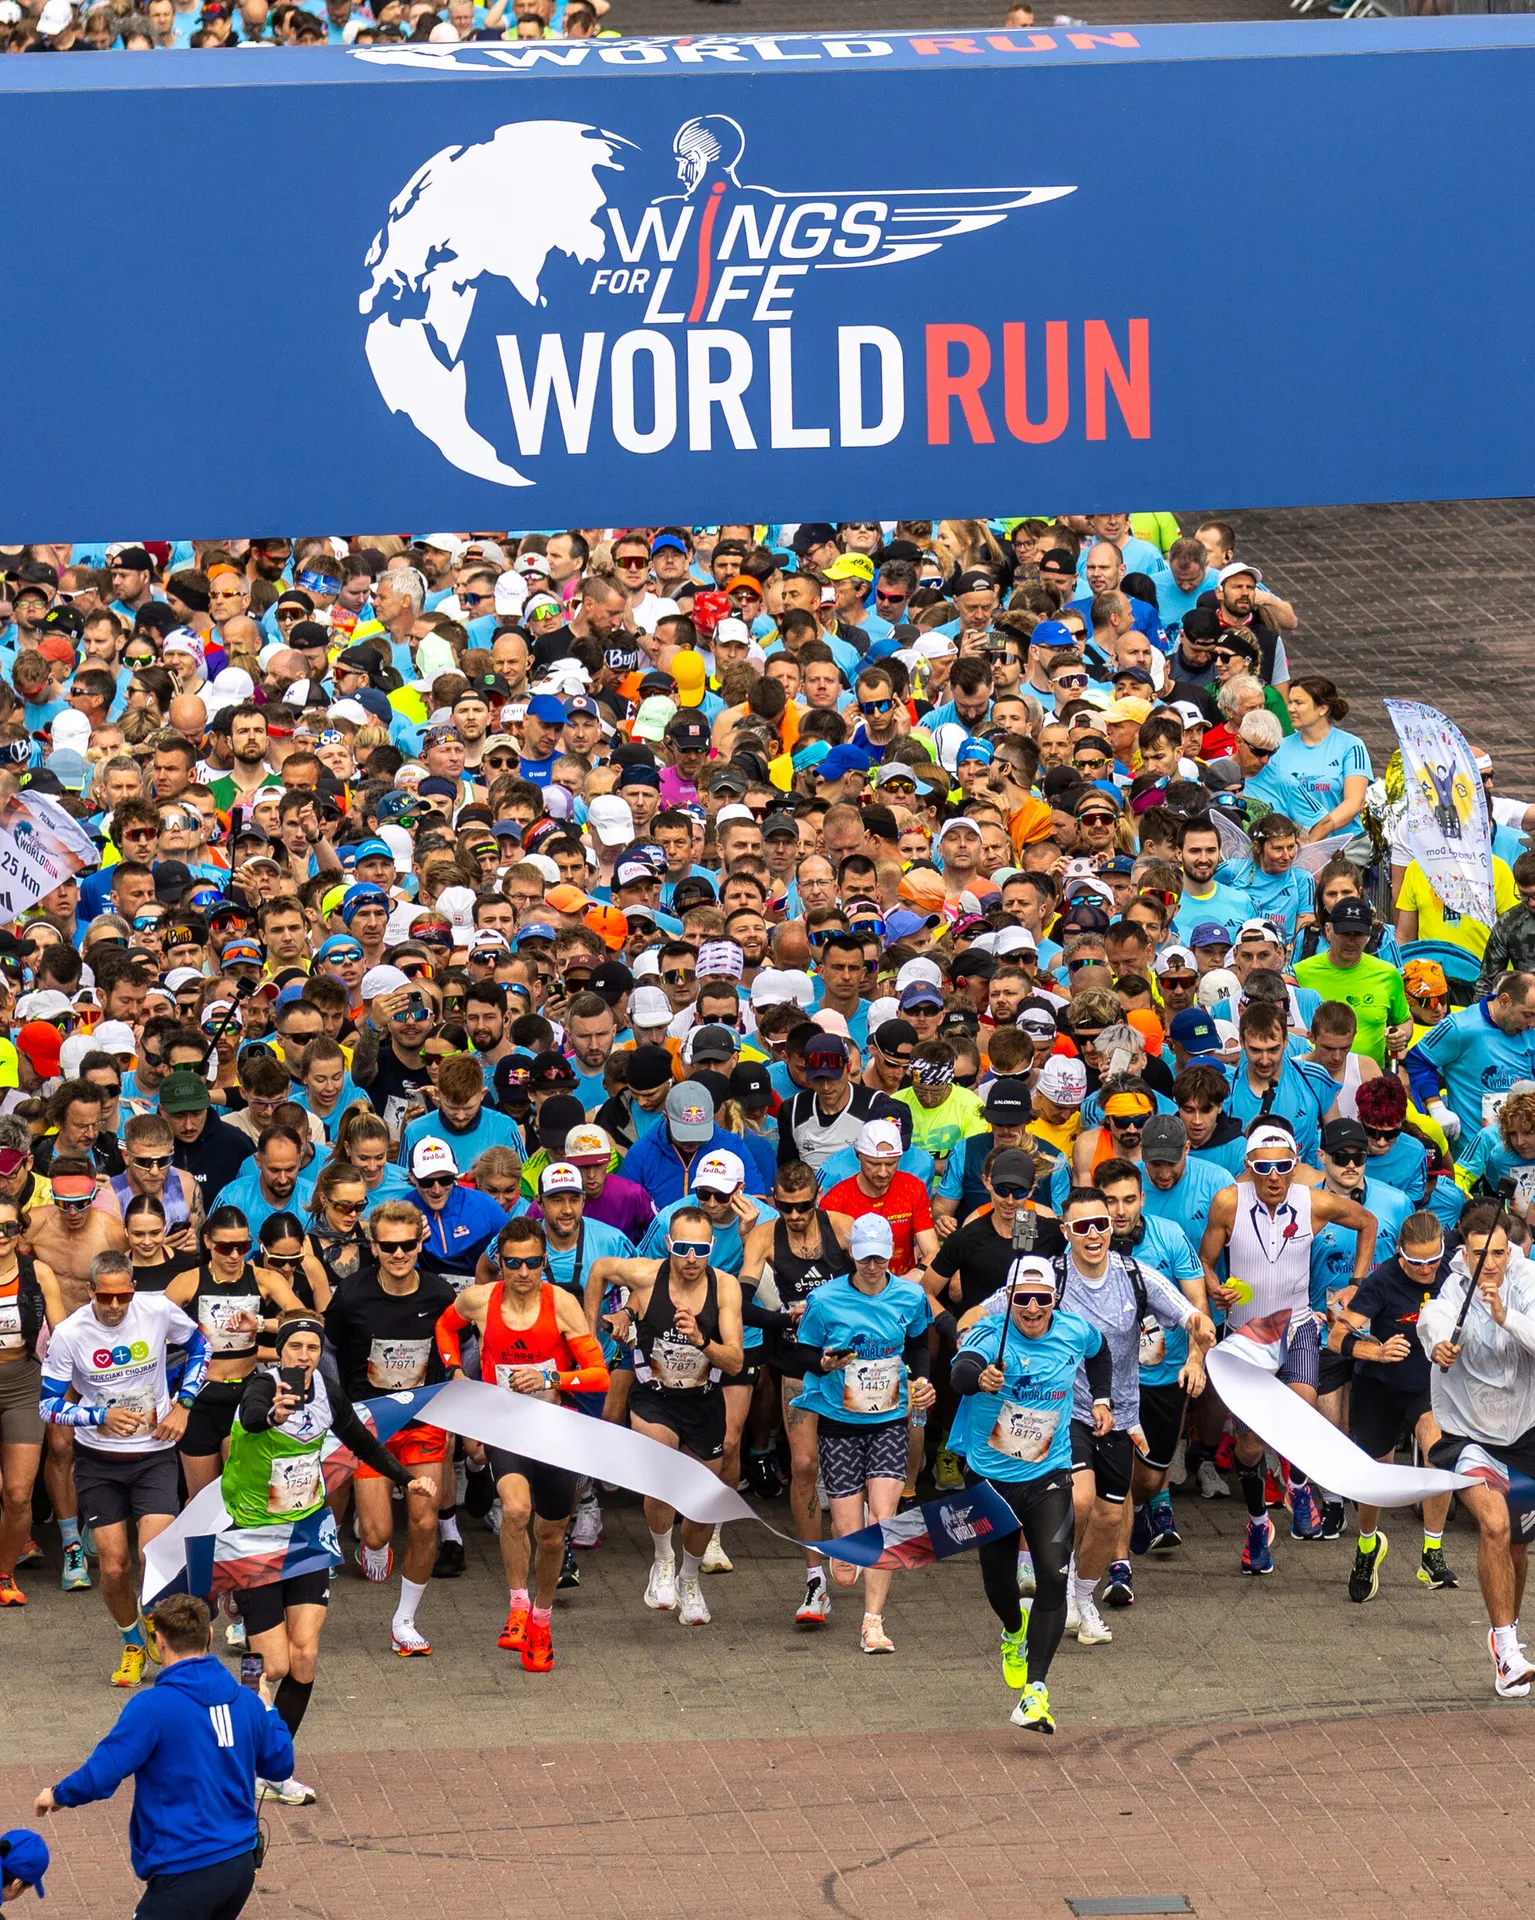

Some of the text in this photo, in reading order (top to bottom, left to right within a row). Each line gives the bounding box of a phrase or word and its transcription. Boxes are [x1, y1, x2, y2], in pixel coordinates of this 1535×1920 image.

[483, 40, 893, 68] WORLD
[908, 31, 1141, 55] RUN
[607, 182, 889, 264] WINGS
[590, 263, 808, 324] FOR LIFE
[496, 318, 1152, 457] WORLD RUN
[1315, 783, 1330, 791] RUN
[20, 836, 46, 867] WORLD
[43, 858, 59, 879] RUN
[1, 851, 42, 898] 25 km
[422, 1154, 434, 1162] Red
[713, 1168, 727, 1176] Bull
[551, 1175, 563, 1184] Red
[384, 1360, 416, 1370] 17971
[665, 1361, 697, 1371] 17871
[90, 1371, 123, 1381] DZIECIAKI
[859, 1379, 891, 1392] 14437
[1021, 1389, 1068, 1401] WORLD RUN
[1009, 1426, 1043, 1441] 18179
[952, 1523, 977, 1541] WORLD
[971, 1516, 993, 1537] RUN
